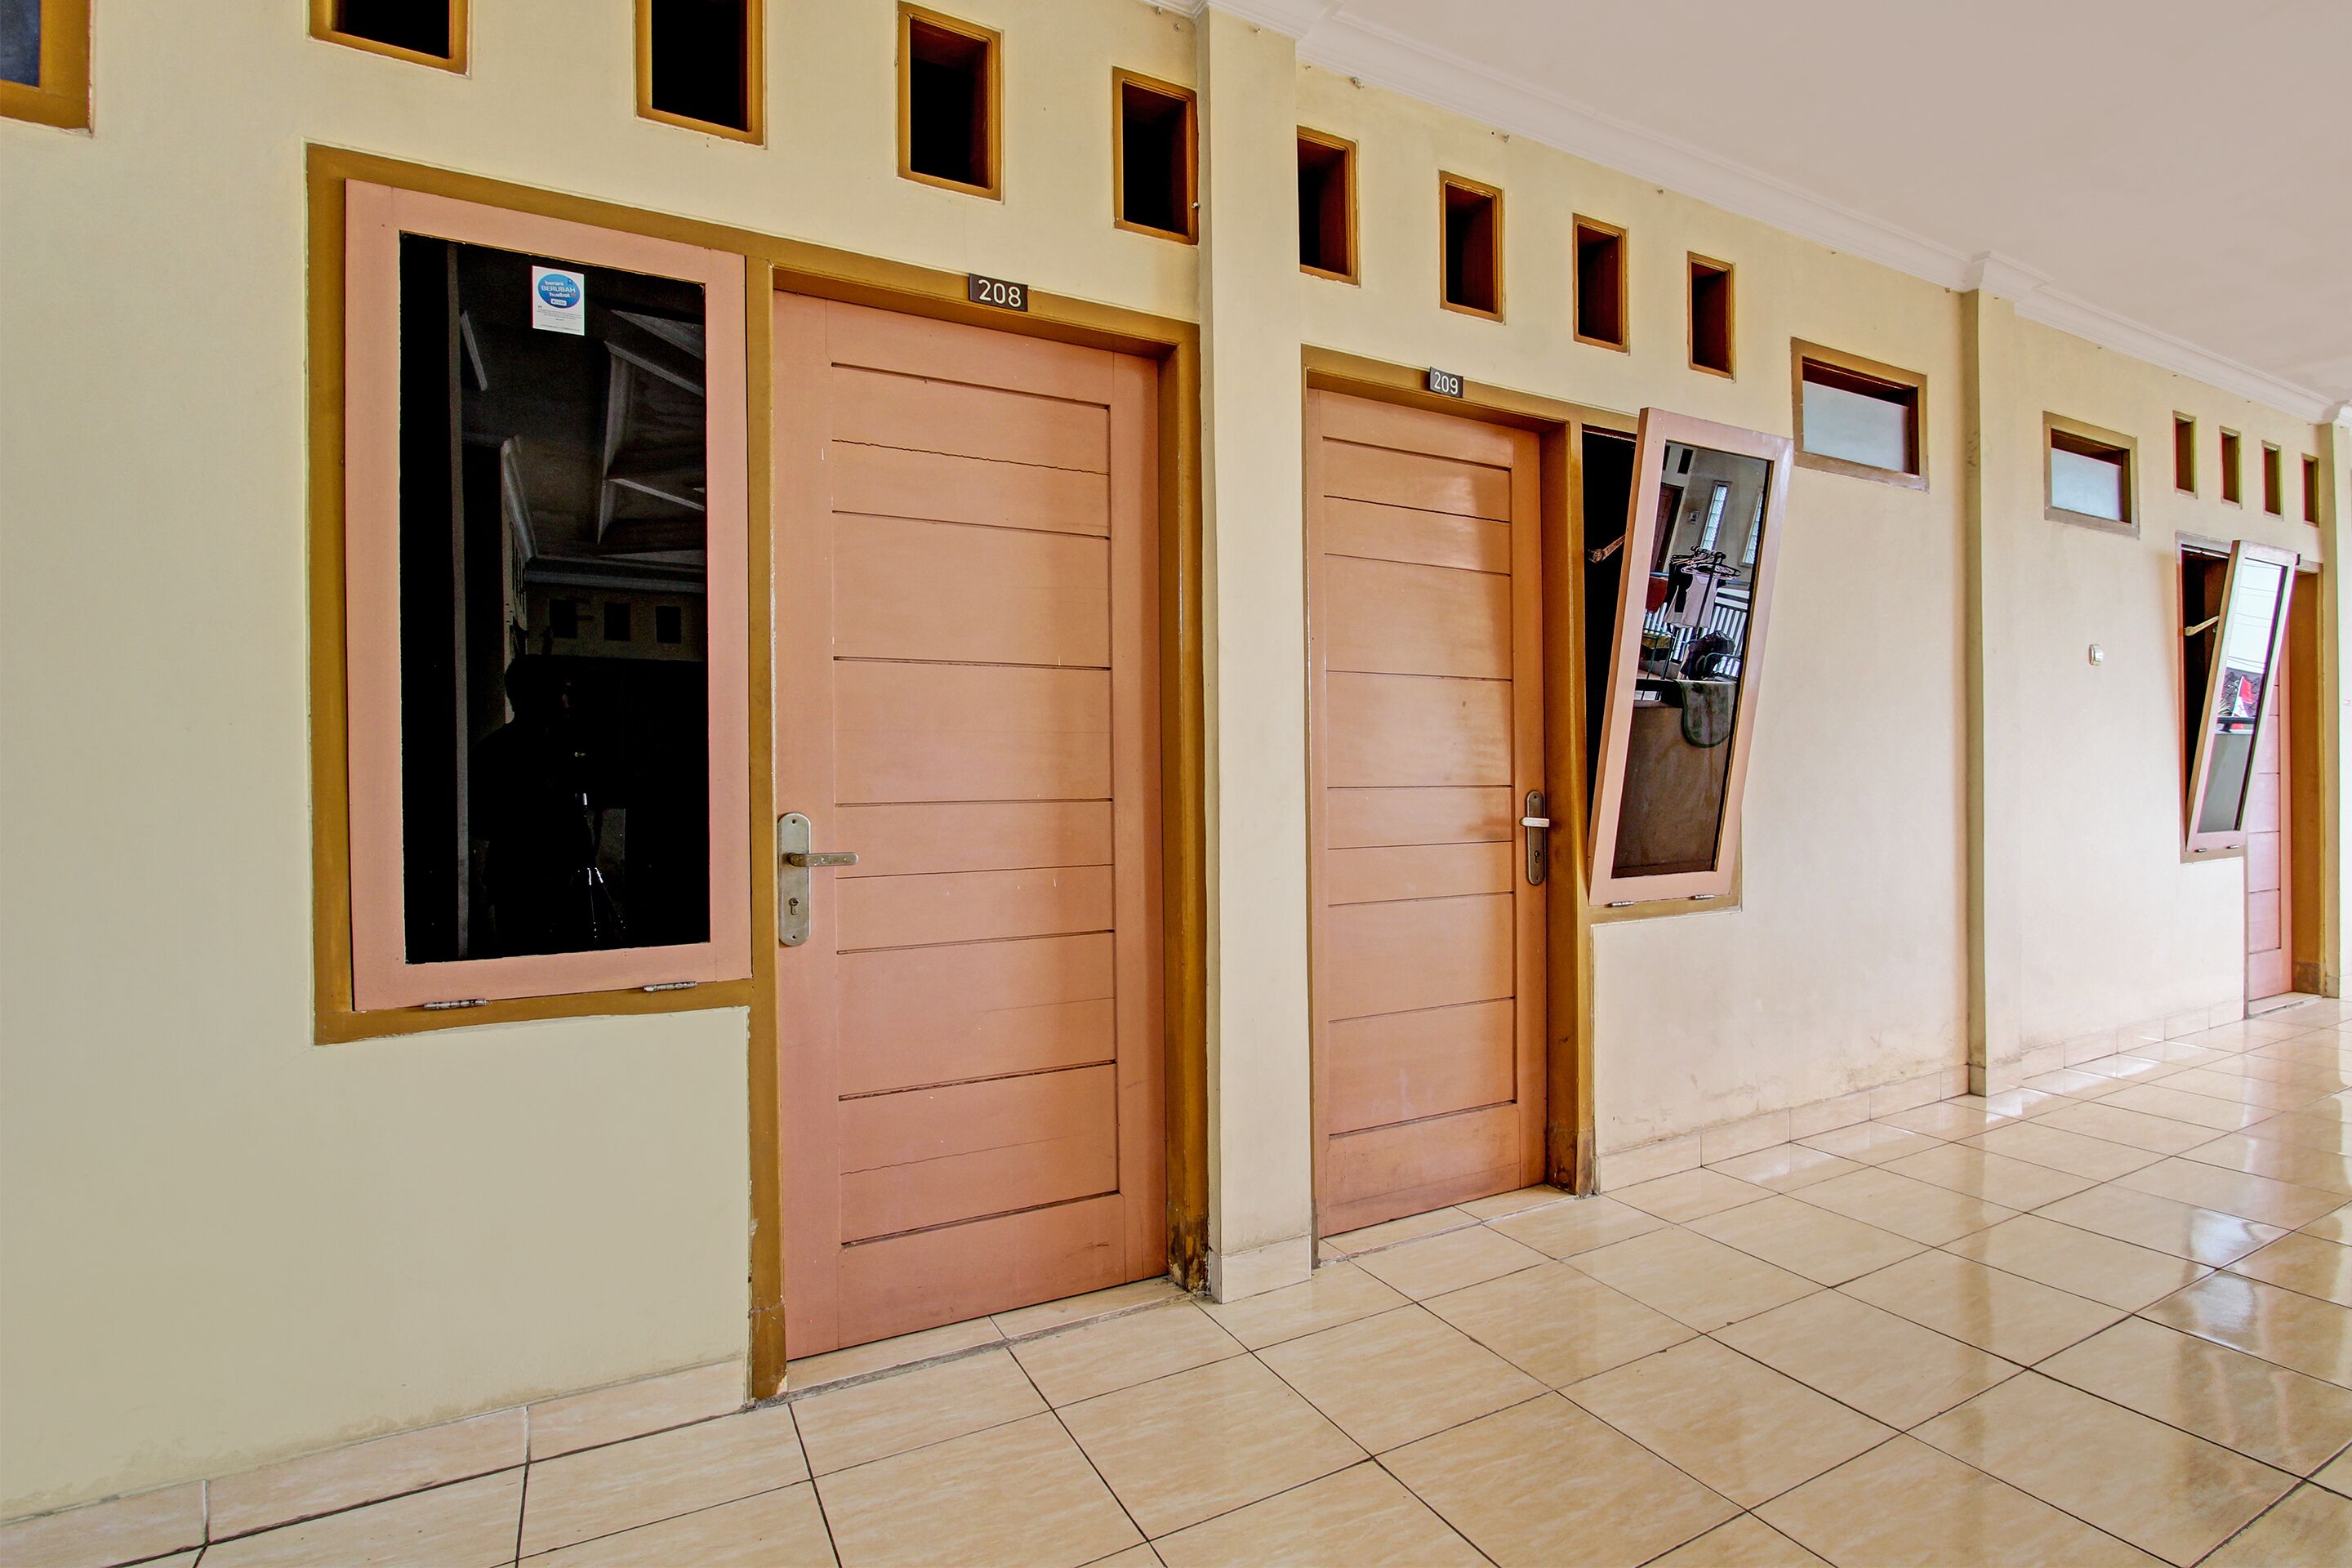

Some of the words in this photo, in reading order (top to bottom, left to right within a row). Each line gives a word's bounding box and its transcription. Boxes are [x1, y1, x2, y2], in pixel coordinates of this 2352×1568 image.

[541, 285, 576, 293] BERUBAH
[978, 279, 1021, 307] 208
[1434, 372, 1458, 394] 209
